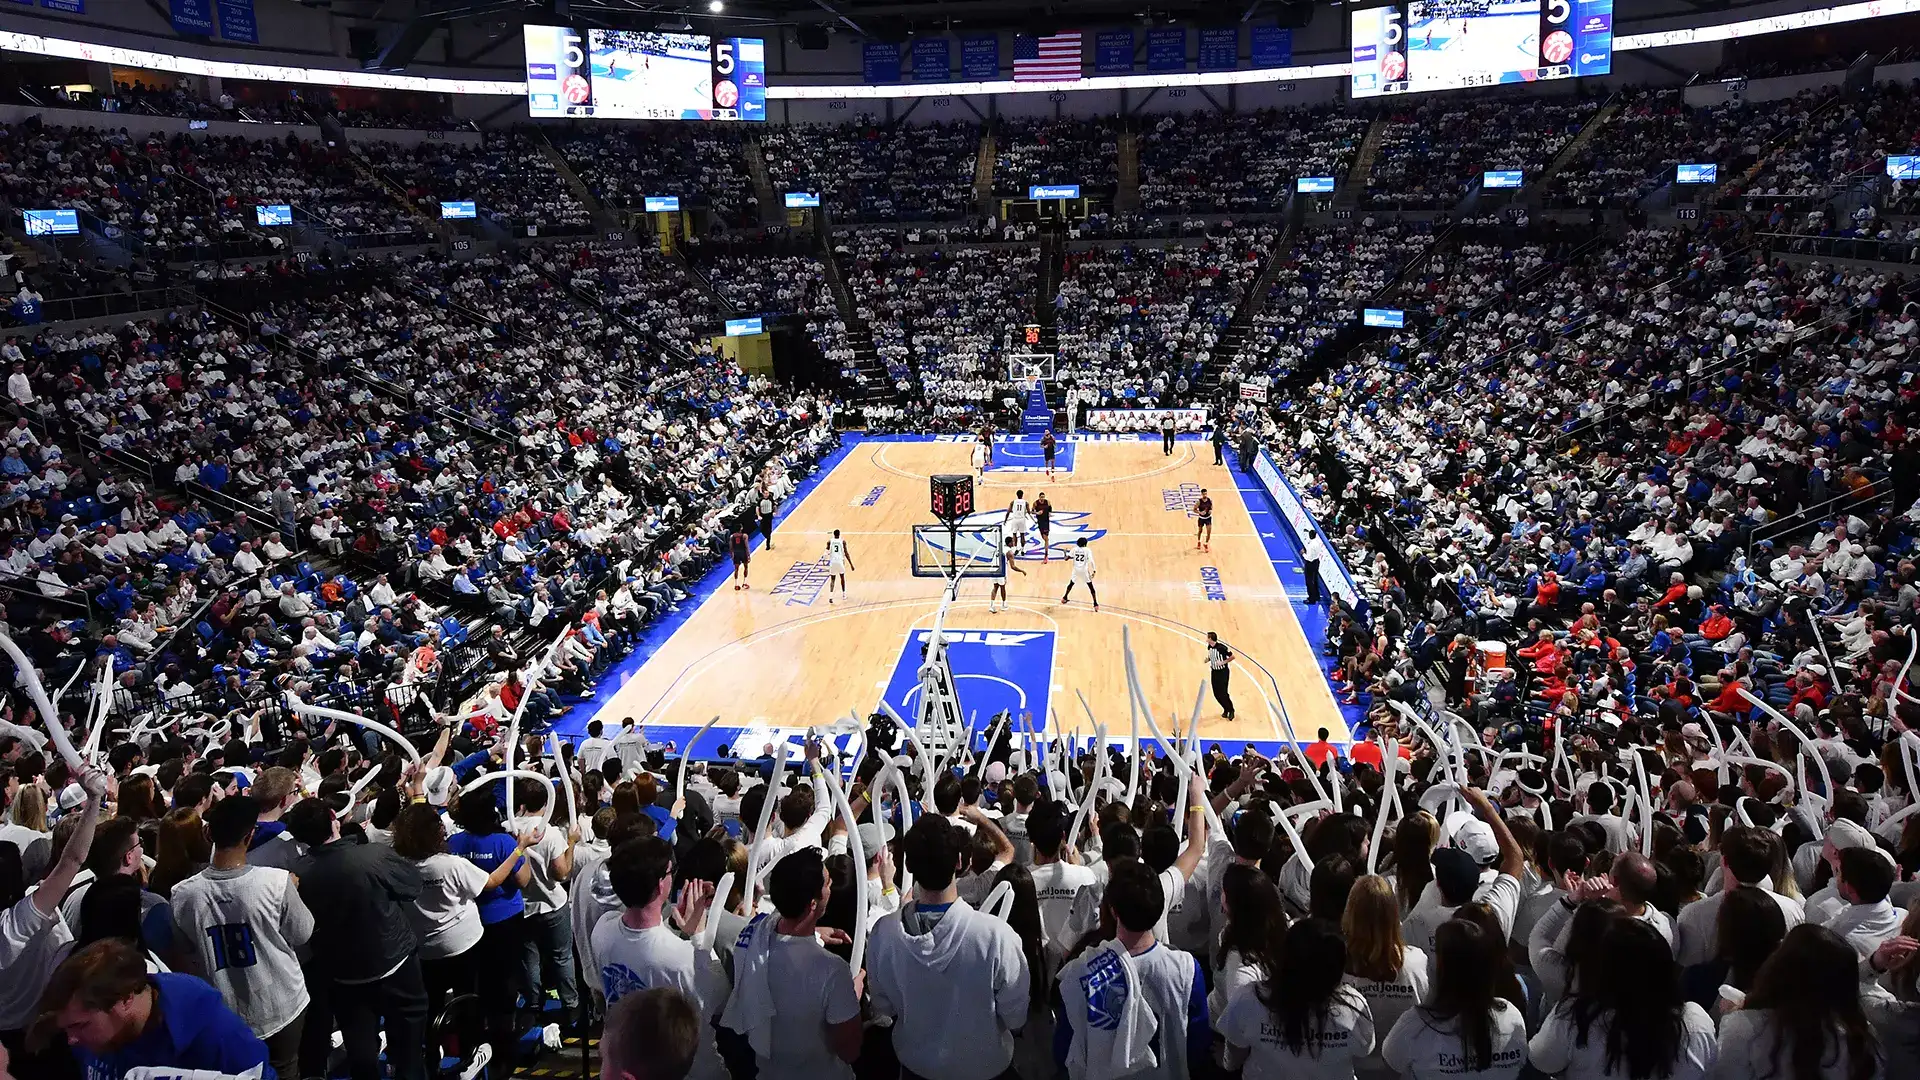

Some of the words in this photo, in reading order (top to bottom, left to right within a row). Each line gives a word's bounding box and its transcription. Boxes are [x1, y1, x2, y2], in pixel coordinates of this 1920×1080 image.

[1547, 0, 1571, 24] 5
[174, 15, 212, 28] TOURNAMENT
[1383, 13, 1402, 45] 5
[563, 35, 584, 68] 5
[717, 44, 734, 75] 5
[1461, 74, 1492, 86] 15:14
[1051, 94, 1066, 102] 209
[647, 109, 675, 118] 15:14
[428, 131, 443, 139] 206
[1335, 211, 1351, 219] 111
[1508, 210, 1525, 218] 112
[1680, 209, 1696, 219] 113
[766, 226, 781, 235] 107
[608, 233, 623, 241] 106
[454, 241, 469, 251] 105
[22, 305, 34, 315] 22
[1241, 387, 1266, 398] ESPN
[933, 492, 944, 514] 28
[955, 492, 970, 514] 28
[1162, 489, 1184, 511] ARENA
[834, 545, 839, 553] 3
[1075, 554, 1085, 562] 22
[769, 561, 815, 596] ARENA
[1201, 566, 1226, 601] CENTENE
[1051, 887, 1075, 896] Jones
[205, 923, 258, 972] 18
[1379, 982, 1414, 994] Jones
[1492, 1049, 1521, 1062] ones
